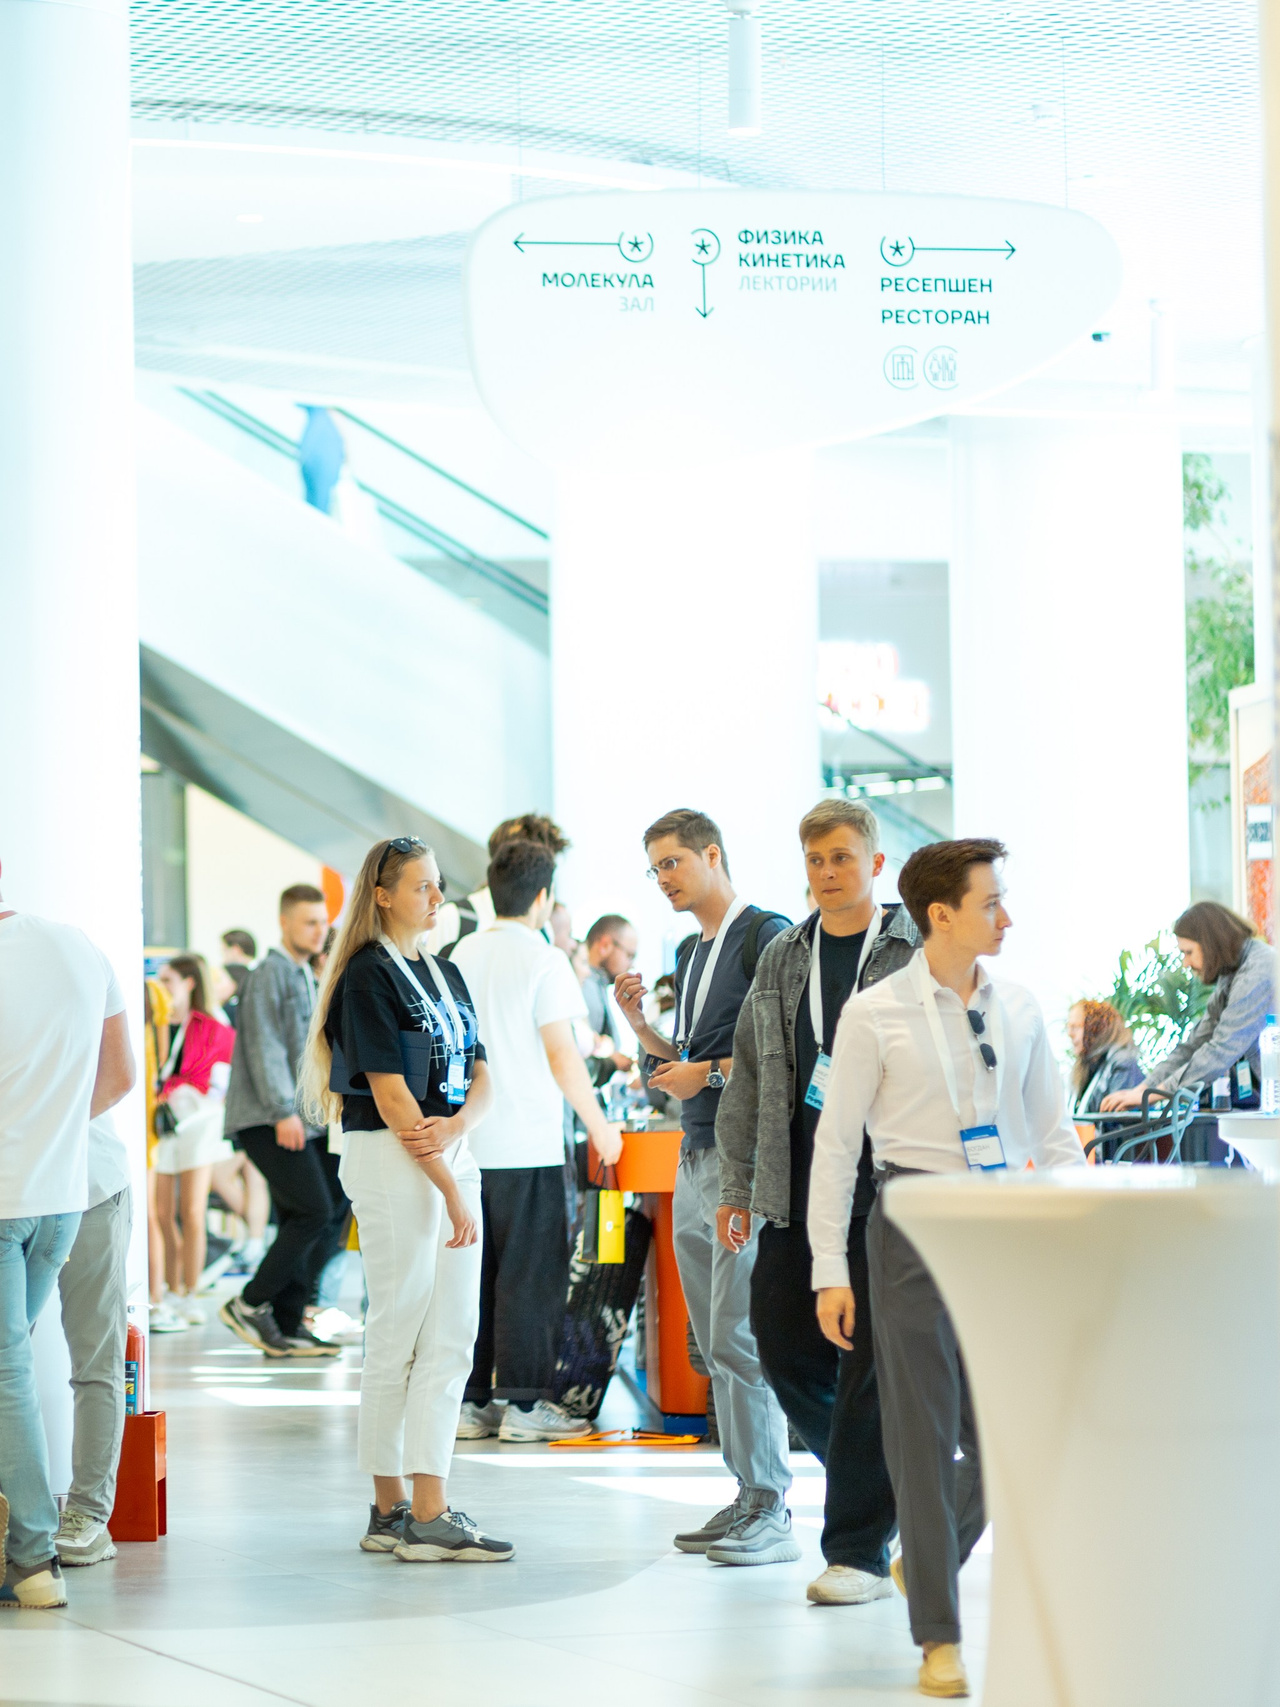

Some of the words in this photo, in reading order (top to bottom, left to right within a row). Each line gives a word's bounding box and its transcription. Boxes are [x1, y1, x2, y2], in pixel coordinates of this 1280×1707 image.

[737, 228, 824, 245] ФИЗИКА
[738, 252, 846, 269] КИНЕТИКА
[541, 272, 655, 289] МОЛЕКУЛА
[738, 275, 838, 292] ЛЕКТОРИИ
[880, 277, 993, 293] РЕСЕПШЕН
[618, 296, 655, 313] ЗАЛ
[881, 308, 991, 325] РЕСТОРАН
